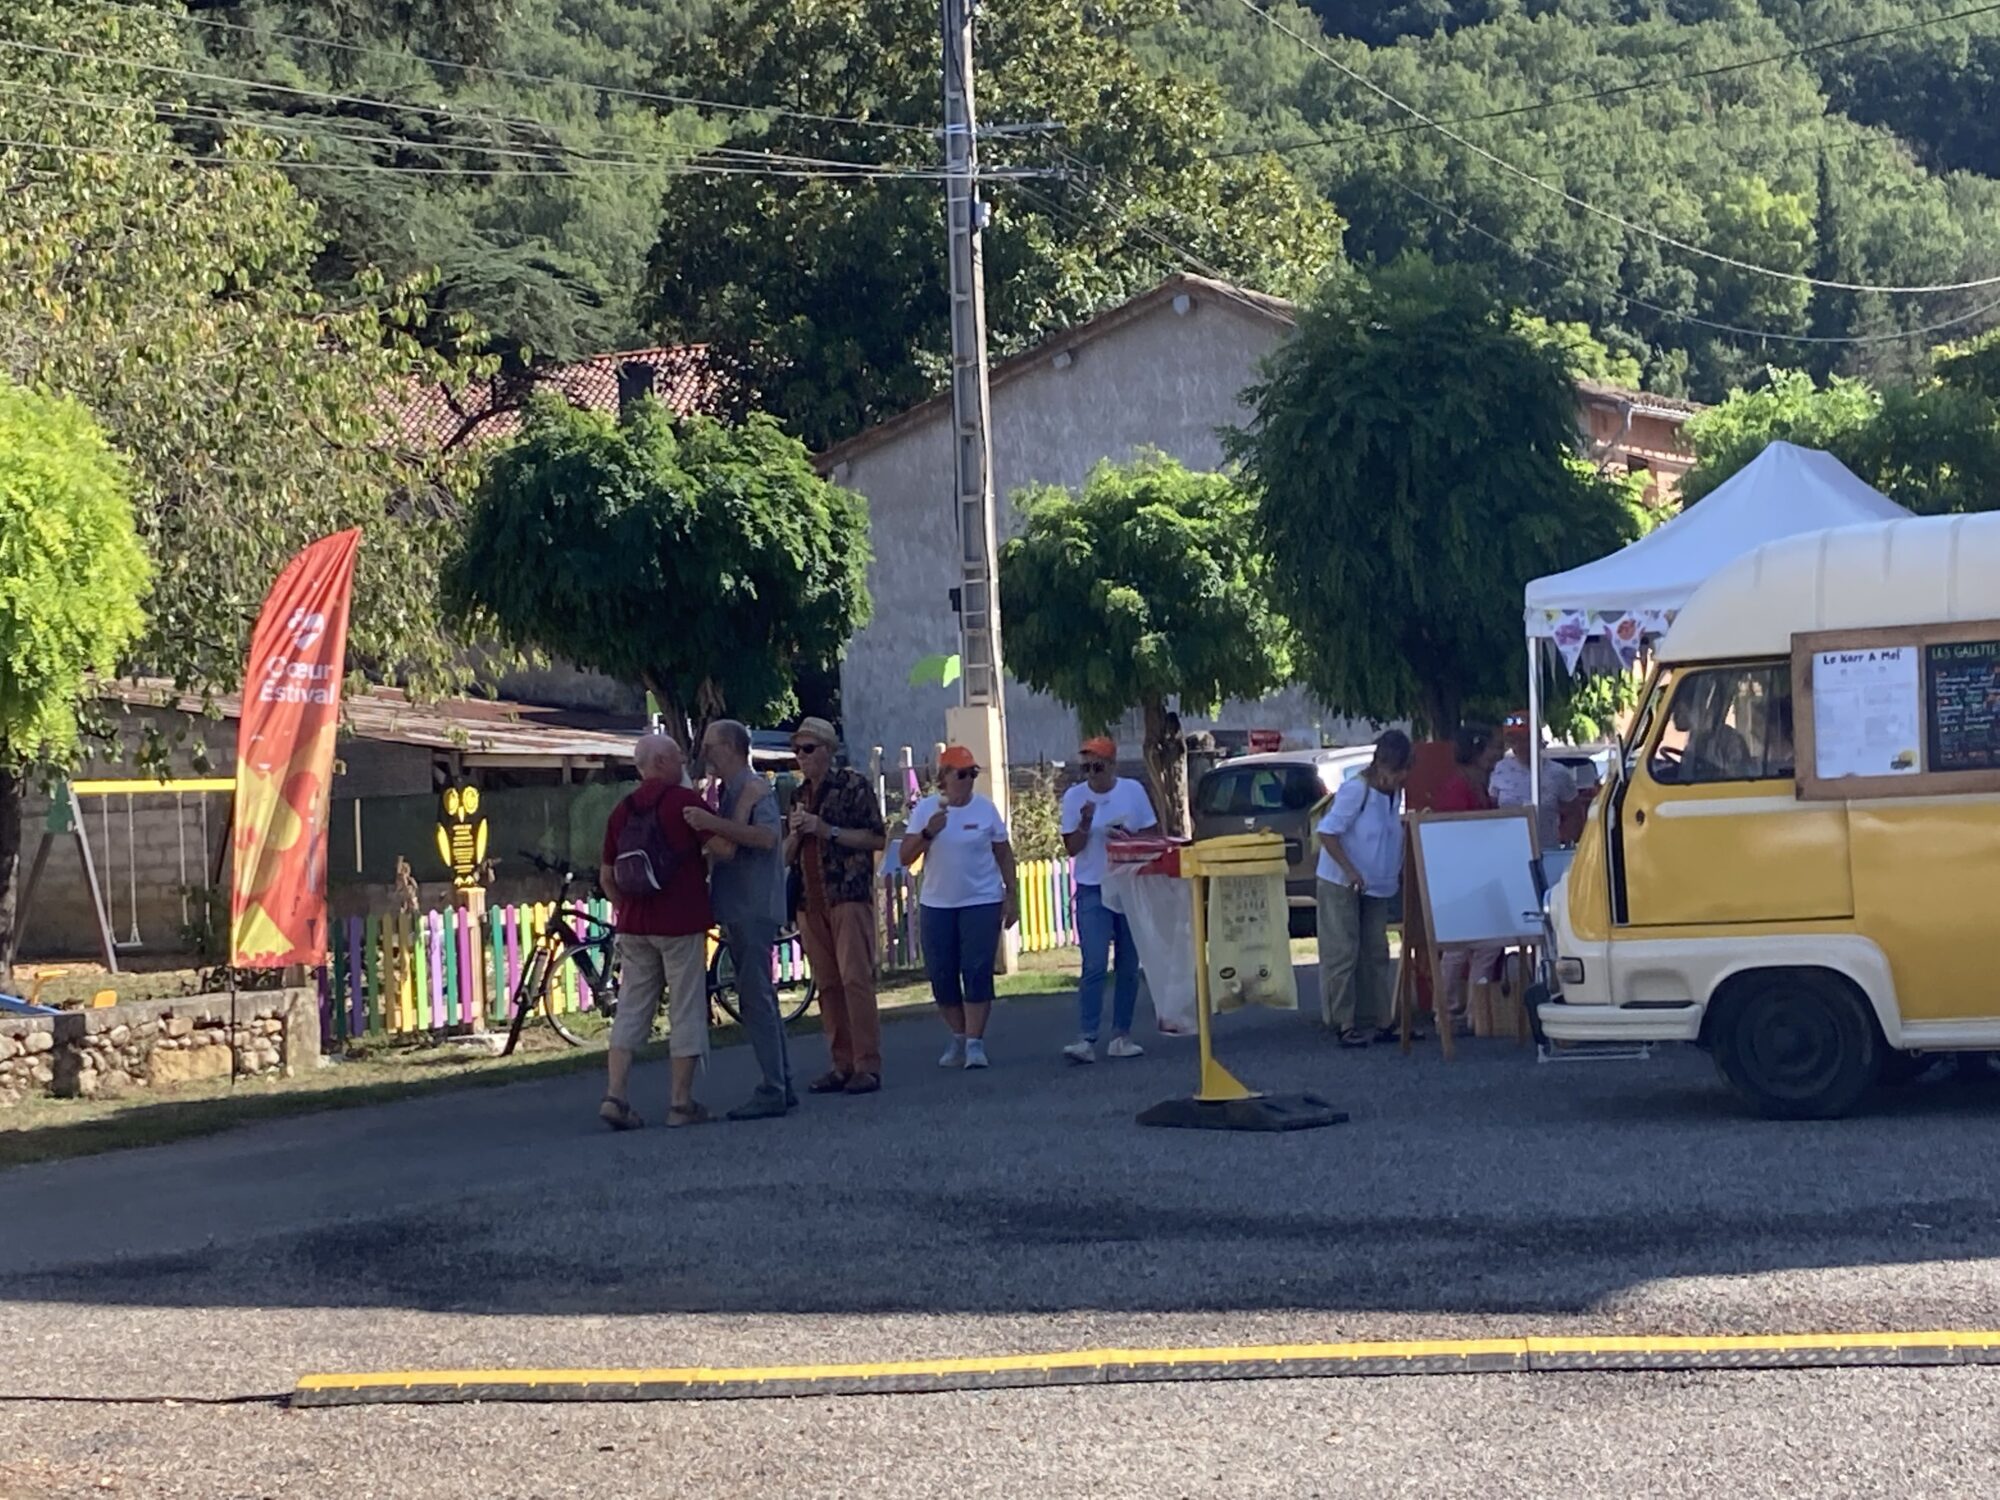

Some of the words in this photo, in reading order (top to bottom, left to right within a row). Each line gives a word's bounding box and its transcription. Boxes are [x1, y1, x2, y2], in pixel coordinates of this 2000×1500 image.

[267, 655, 334, 679] Cœur
[1823, 655, 1837, 665] Le
[260, 680, 335, 704] Estival
